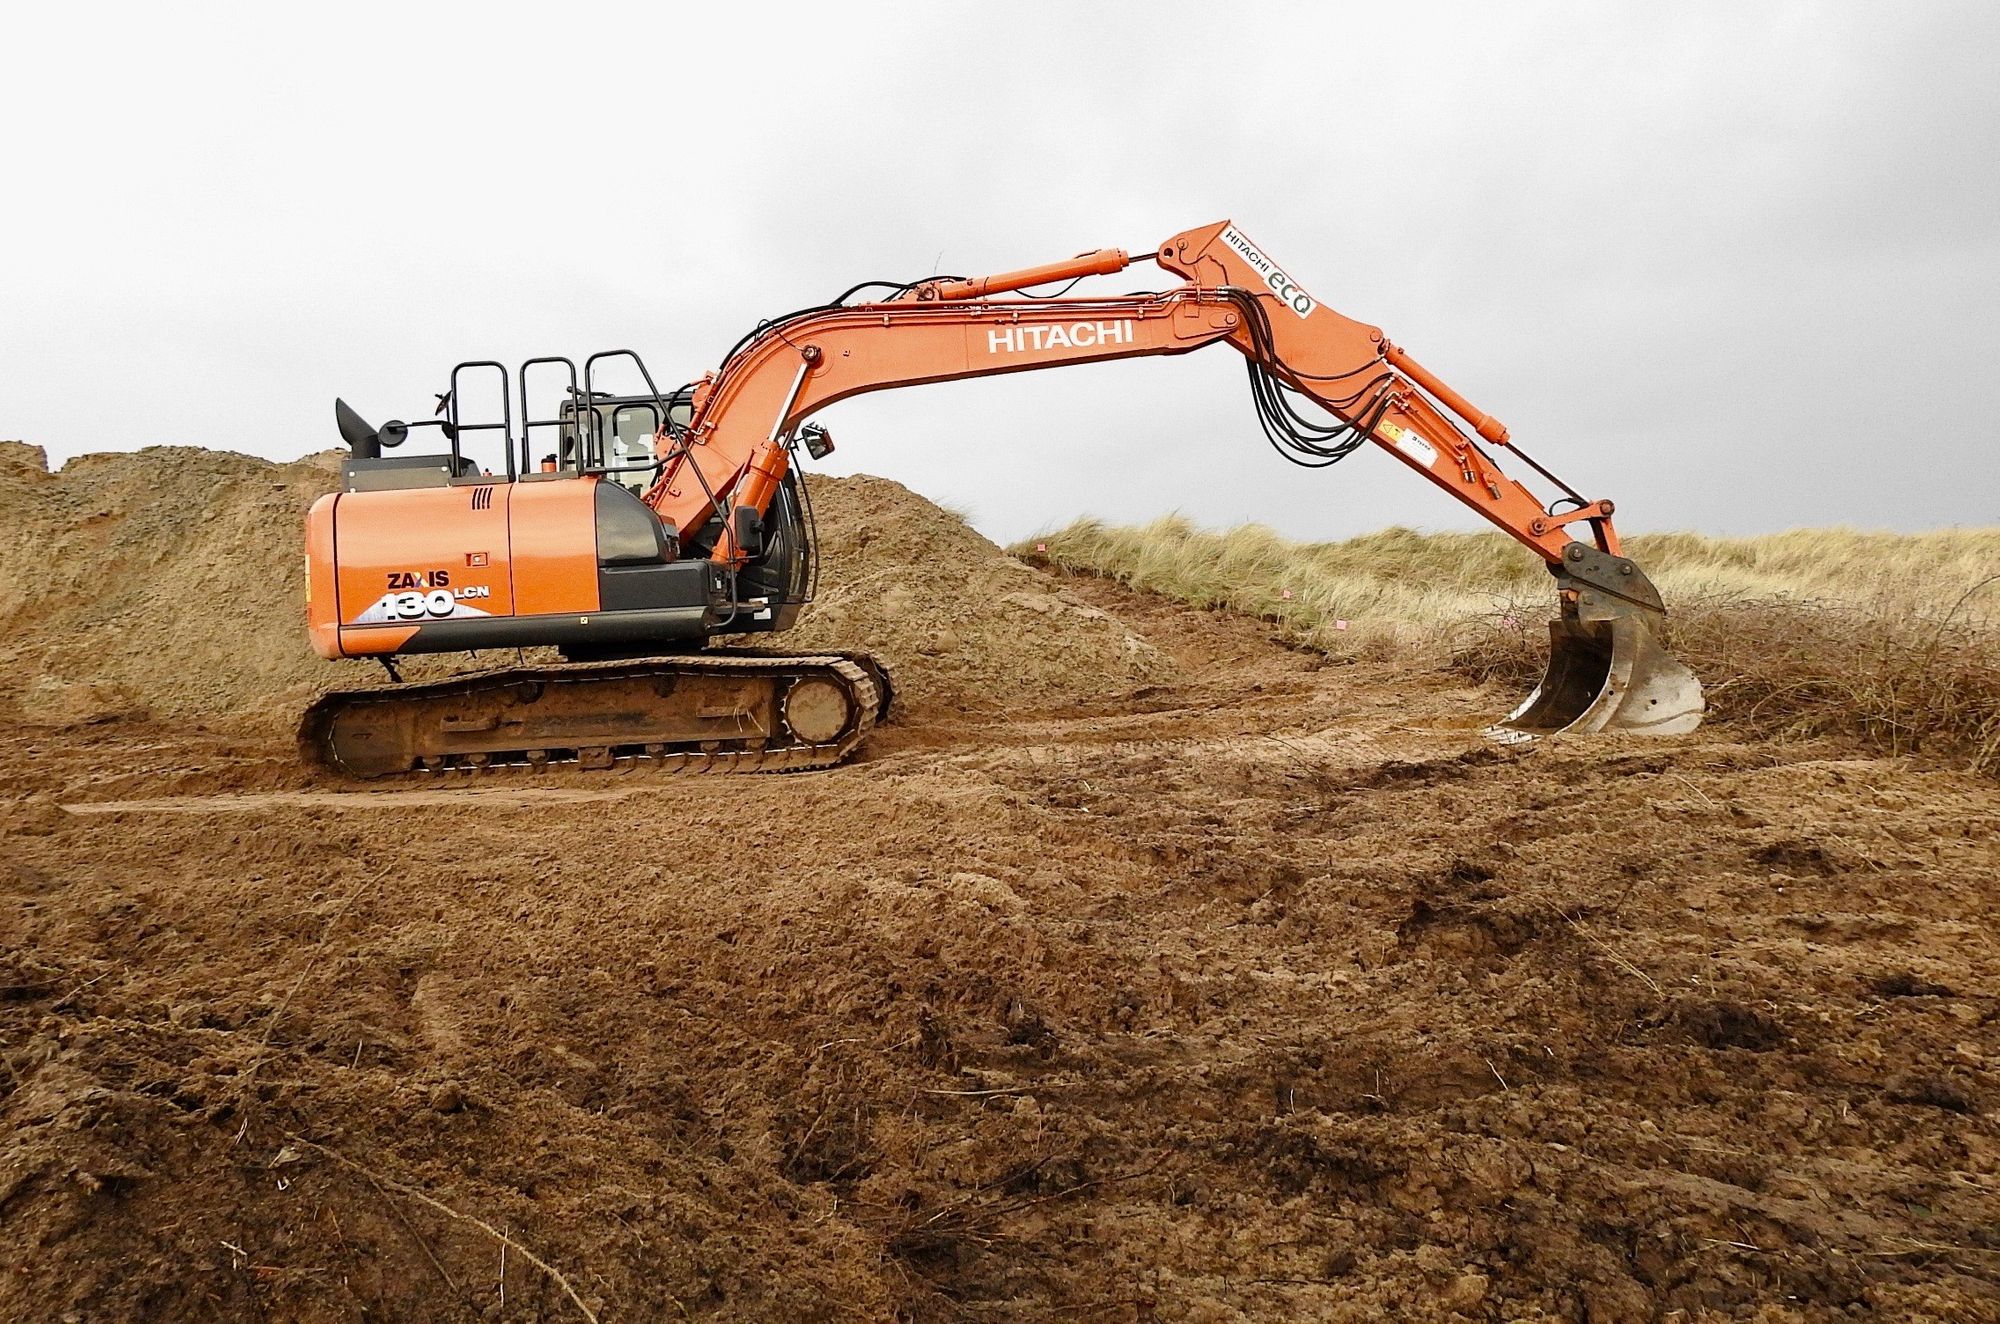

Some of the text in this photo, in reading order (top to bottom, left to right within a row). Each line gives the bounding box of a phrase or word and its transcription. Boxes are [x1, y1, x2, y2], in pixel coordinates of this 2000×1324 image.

[1225, 231, 1270, 272] HITACHI
[987, 319, 1134, 354] HITACHI
[387, 570, 450, 589] ZAXIS
